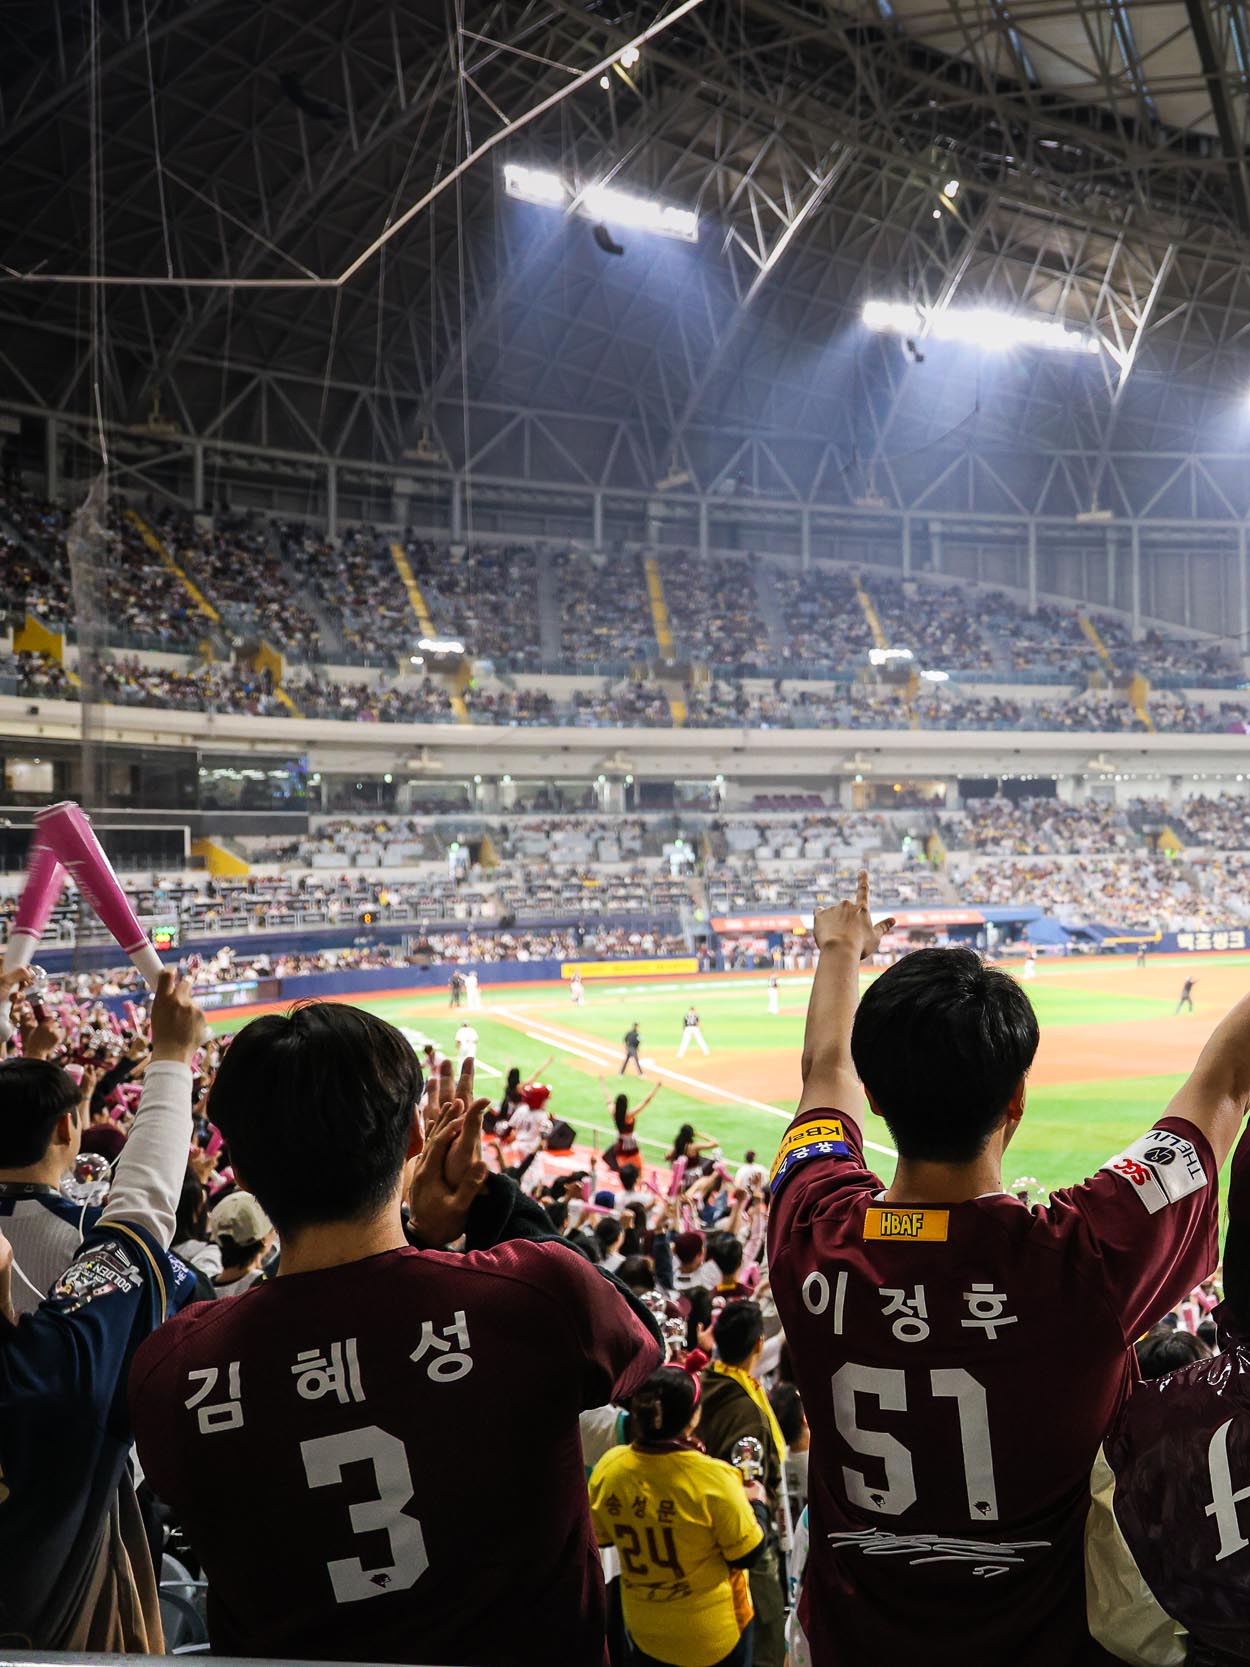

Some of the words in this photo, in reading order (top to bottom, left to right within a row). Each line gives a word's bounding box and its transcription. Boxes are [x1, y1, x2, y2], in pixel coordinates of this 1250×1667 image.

[880, 1212, 924, 1237] HBAF
[802, 1271, 1018, 1343] 이정후
[185, 1310, 473, 1434] 김혜성
[831, 1362, 999, 1521] 51
[300, 1425, 430, 1604] 3
[614, 1524, 686, 1580] 24
